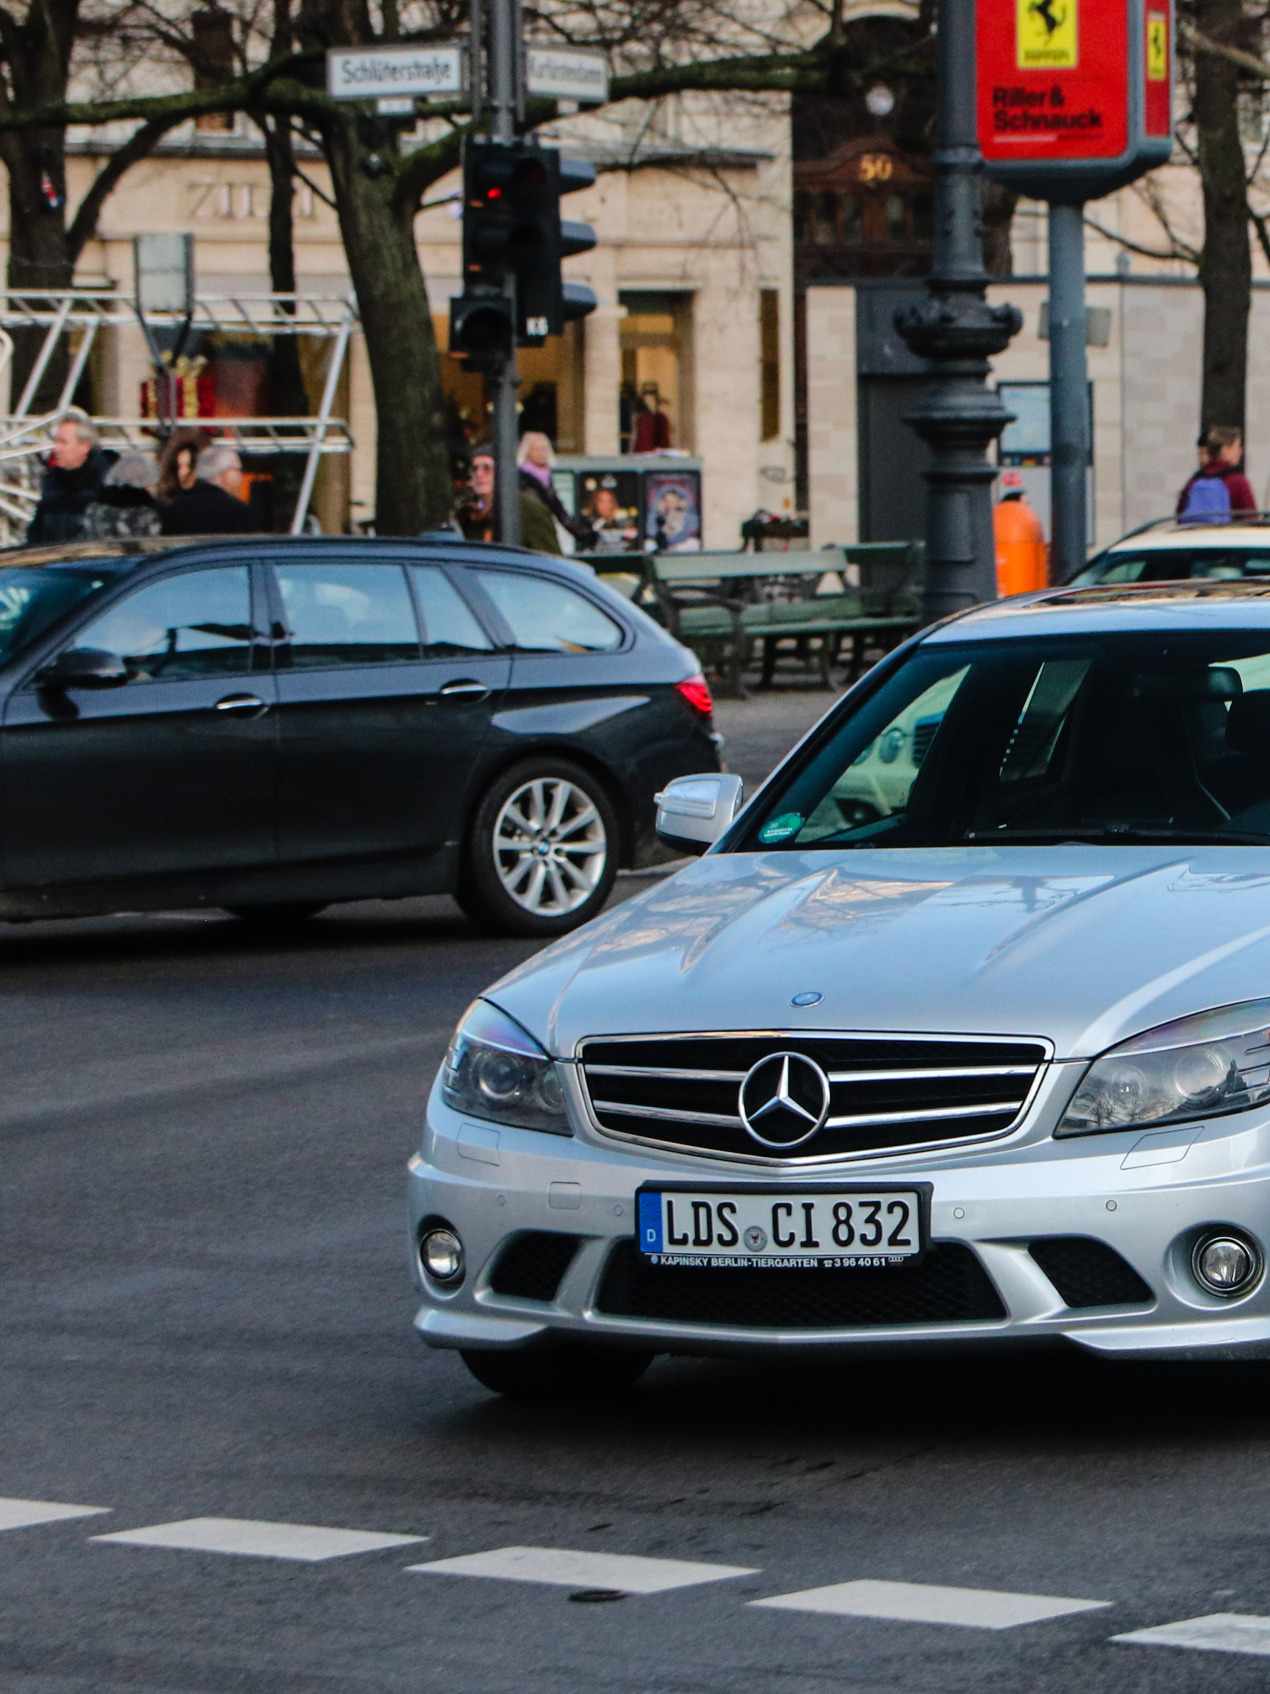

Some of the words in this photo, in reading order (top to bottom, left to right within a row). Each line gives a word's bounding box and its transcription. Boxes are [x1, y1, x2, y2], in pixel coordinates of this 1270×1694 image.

[993, 86, 1046, 108] Riller
[1051, 84, 1065, 106] &
[993, 108, 1102, 130] Schnauck
[666, 1199, 739, 1247] LDS
[771, 1202, 820, 1248] CI
[831, 1200, 912, 1247] 832
[646, 1229, 656, 1242] D
[660, 1256, 708, 1266] KAPINSKY
[711, 1257, 818, 1268] BERLIN-TIERGARTEN
